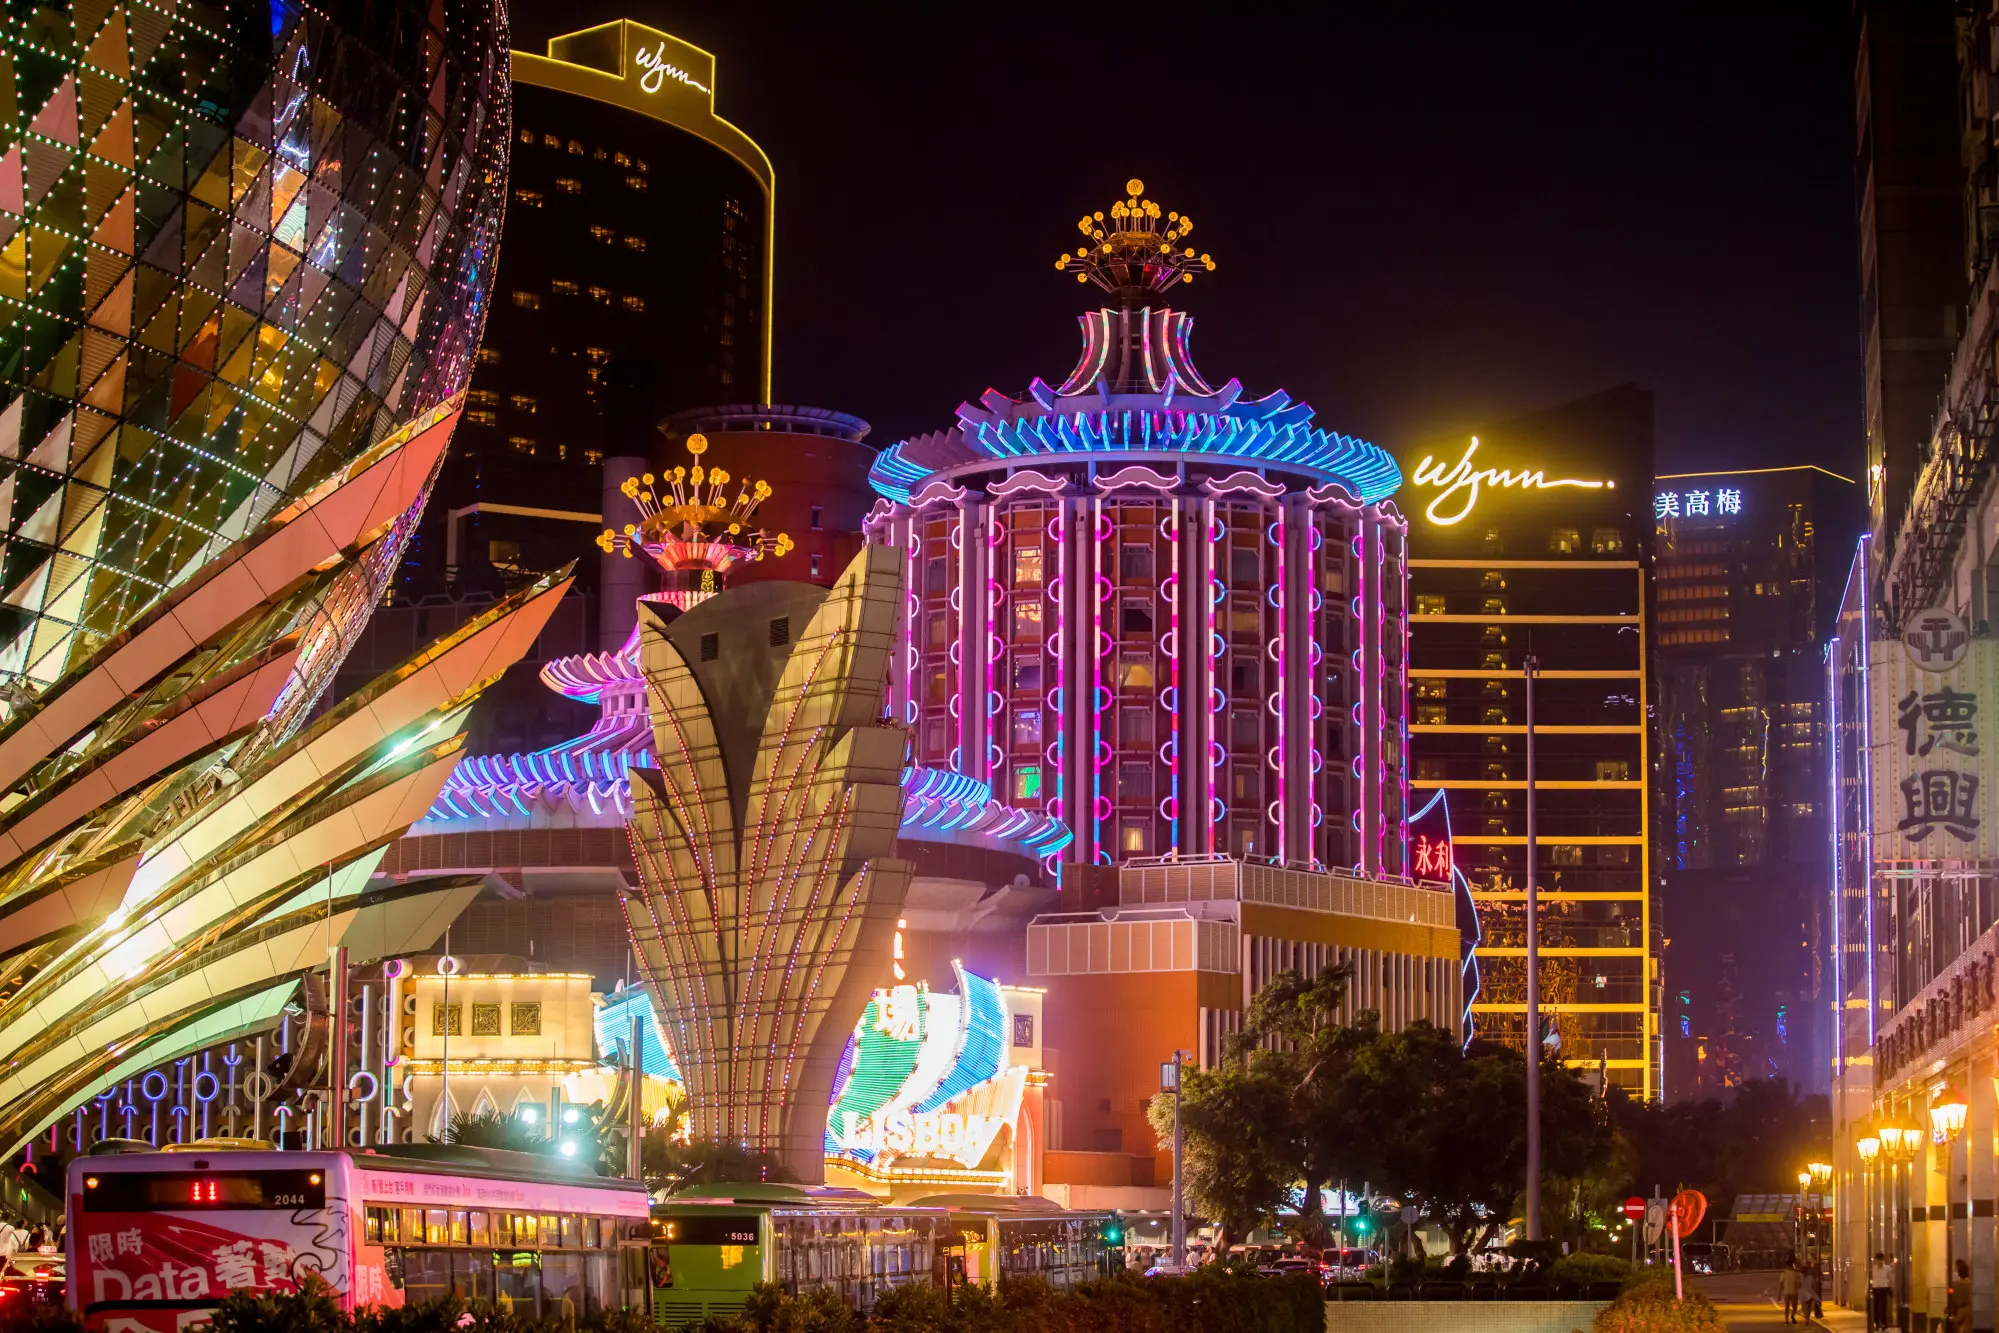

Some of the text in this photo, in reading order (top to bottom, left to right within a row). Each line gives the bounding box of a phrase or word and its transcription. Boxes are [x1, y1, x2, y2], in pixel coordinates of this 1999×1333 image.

[1655, 488, 1742, 519] 美高梅
[1898, 685, 1980, 843] 德興
[1415, 835, 1452, 881] 永利
[842, 1111, 992, 1150] LISBOA
[192, 1181, 217, 1201] 11
[274, 1194, 305, 1205] 2044
[88, 1226, 143, 1263] 限時
[731, 1232, 754, 1241] 5036
[93, 1261, 210, 1302] Data
